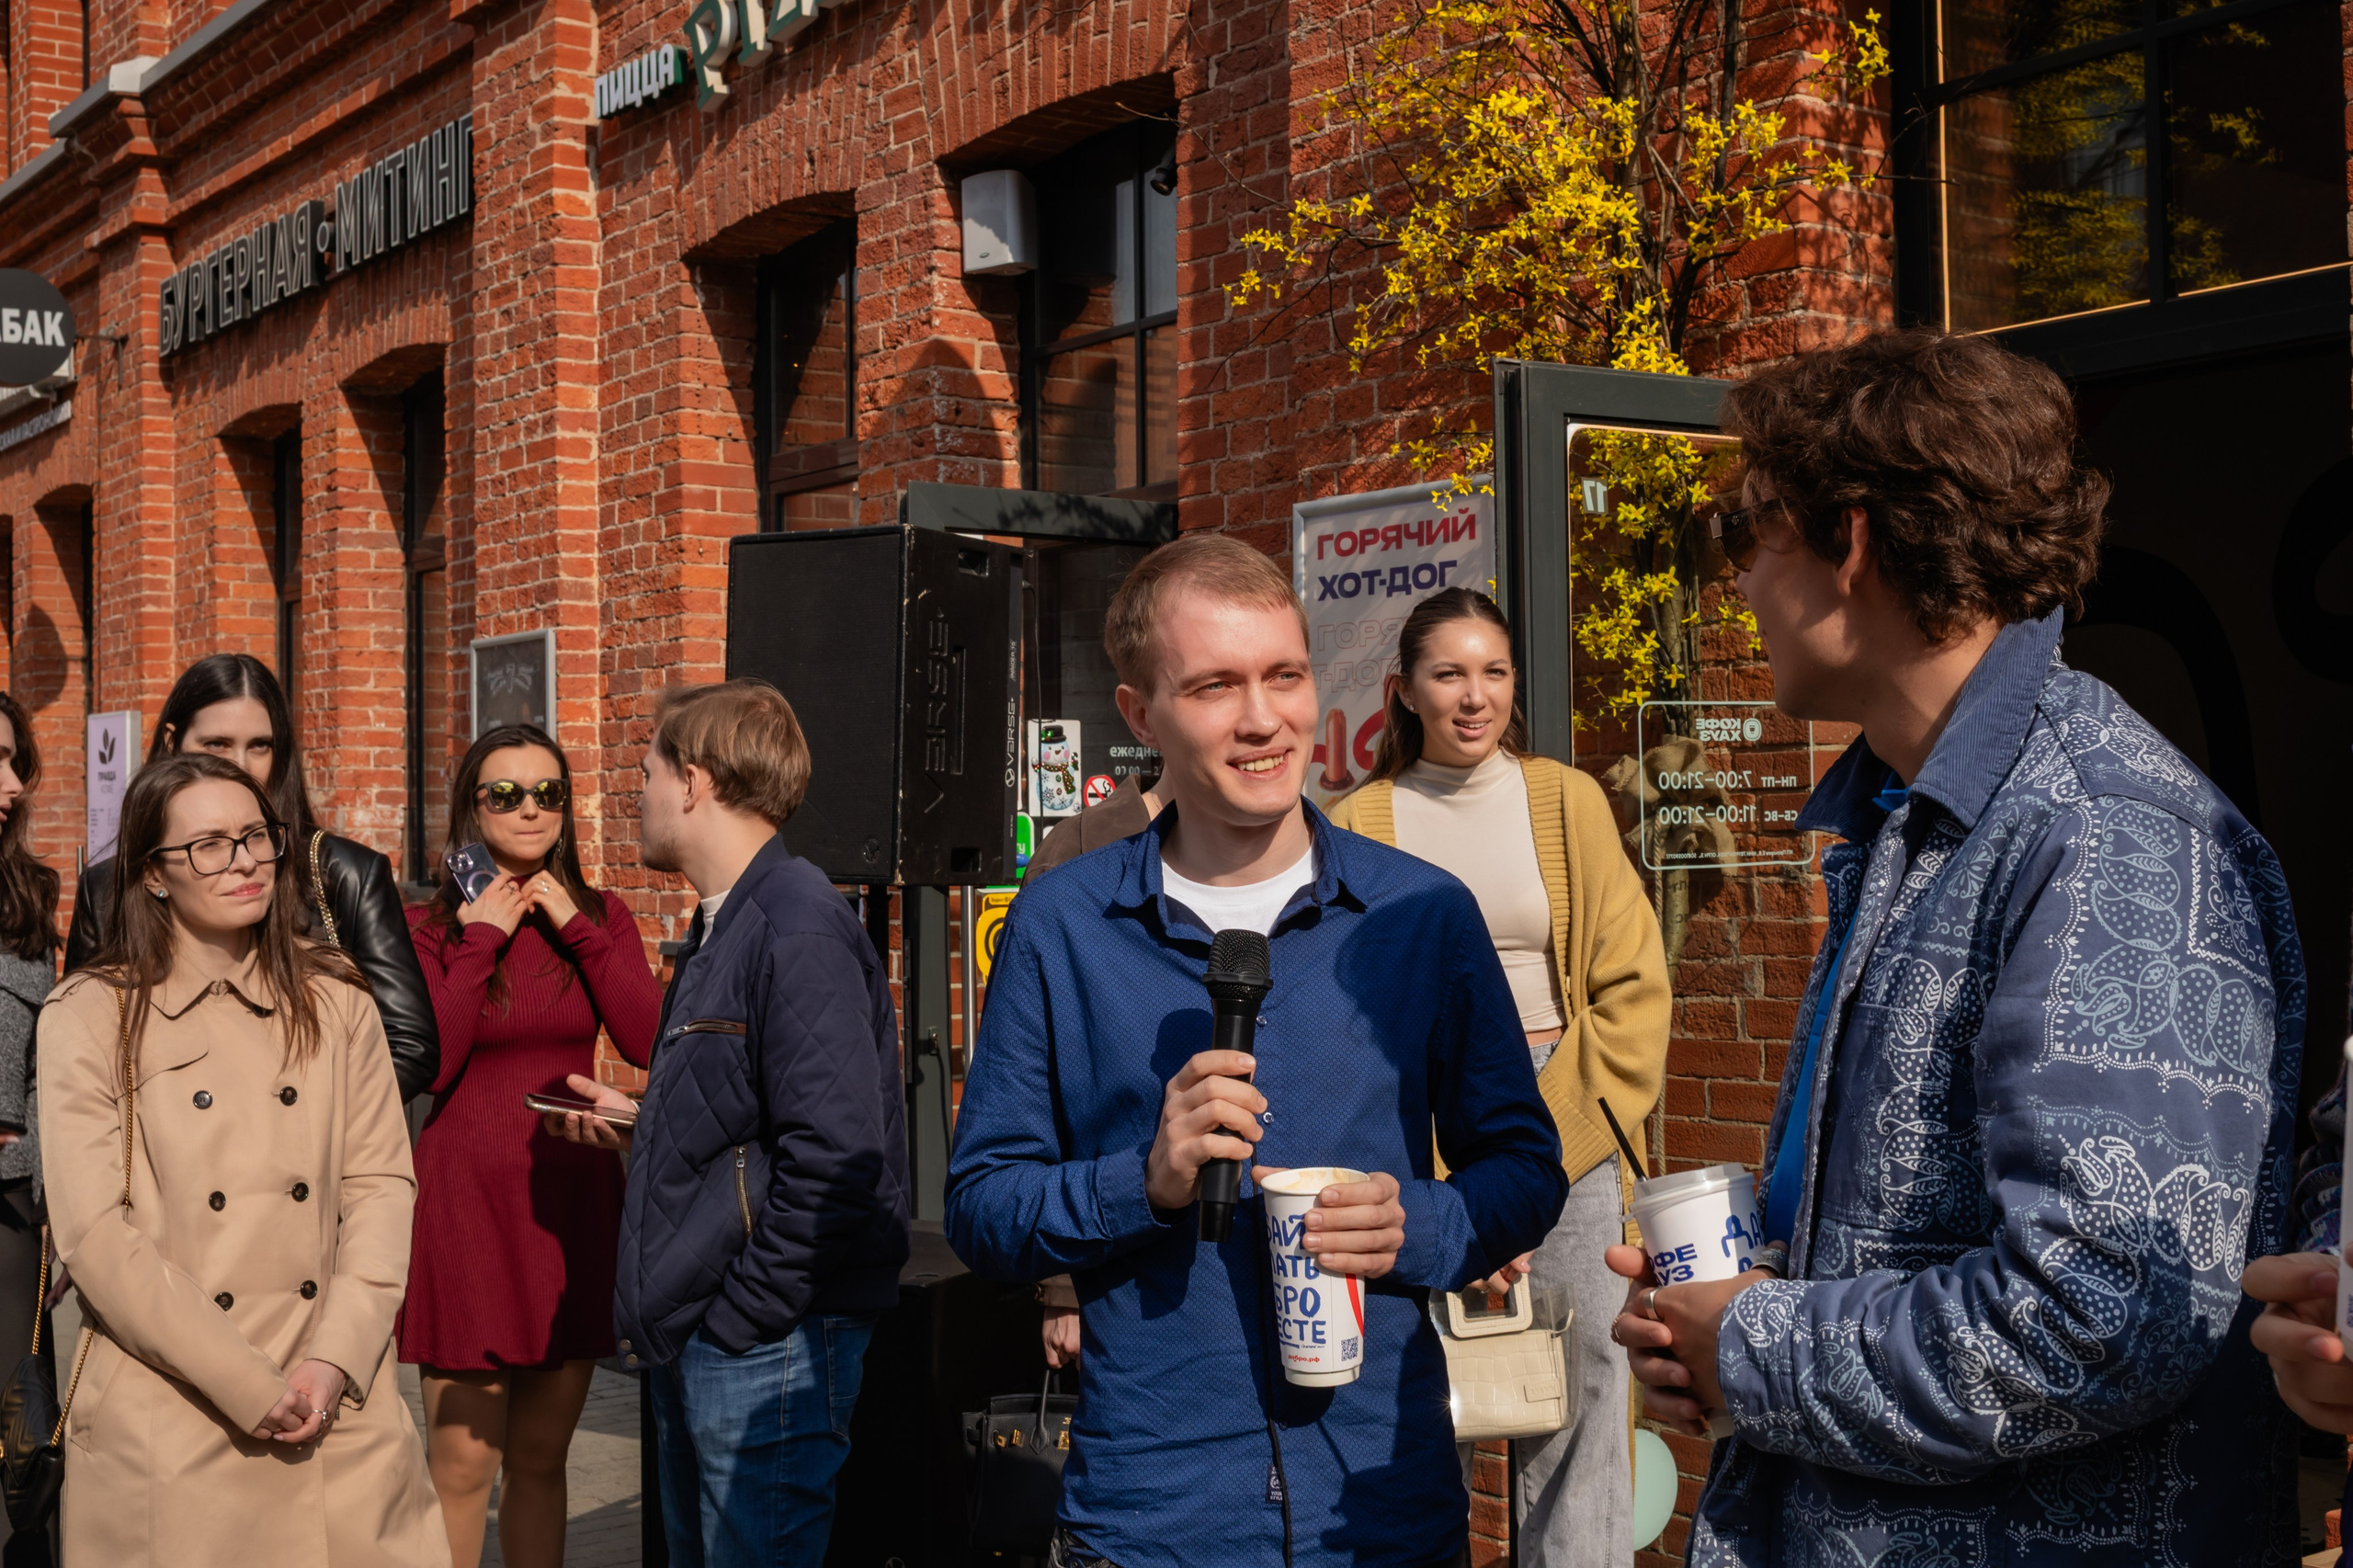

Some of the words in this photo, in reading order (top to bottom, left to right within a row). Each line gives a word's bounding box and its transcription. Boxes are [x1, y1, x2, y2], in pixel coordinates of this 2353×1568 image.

[594, 43, 674, 119] ПИЦЦА
[159, 200, 312, 358] БУРГЕРНАЯ
[335, 112, 473, 273] МИТИНГ
[0, 307, 65, 347] БАК
[1317, 507, 1476, 561] ГОРЯЧИЙ
[1317, 560, 1458, 602] ХОТ-ДОГ
[1317, 616, 1409, 652] ГОРЯ
[1007, 701, 1016, 766] VERSE
[1109, 746, 1161, 760] ежедне
[1650, 1243, 1698, 1268] ФЕ
[1721, 1211, 1766, 1258] ДА
[1288, 1354, 1320, 1363] добро.рф
